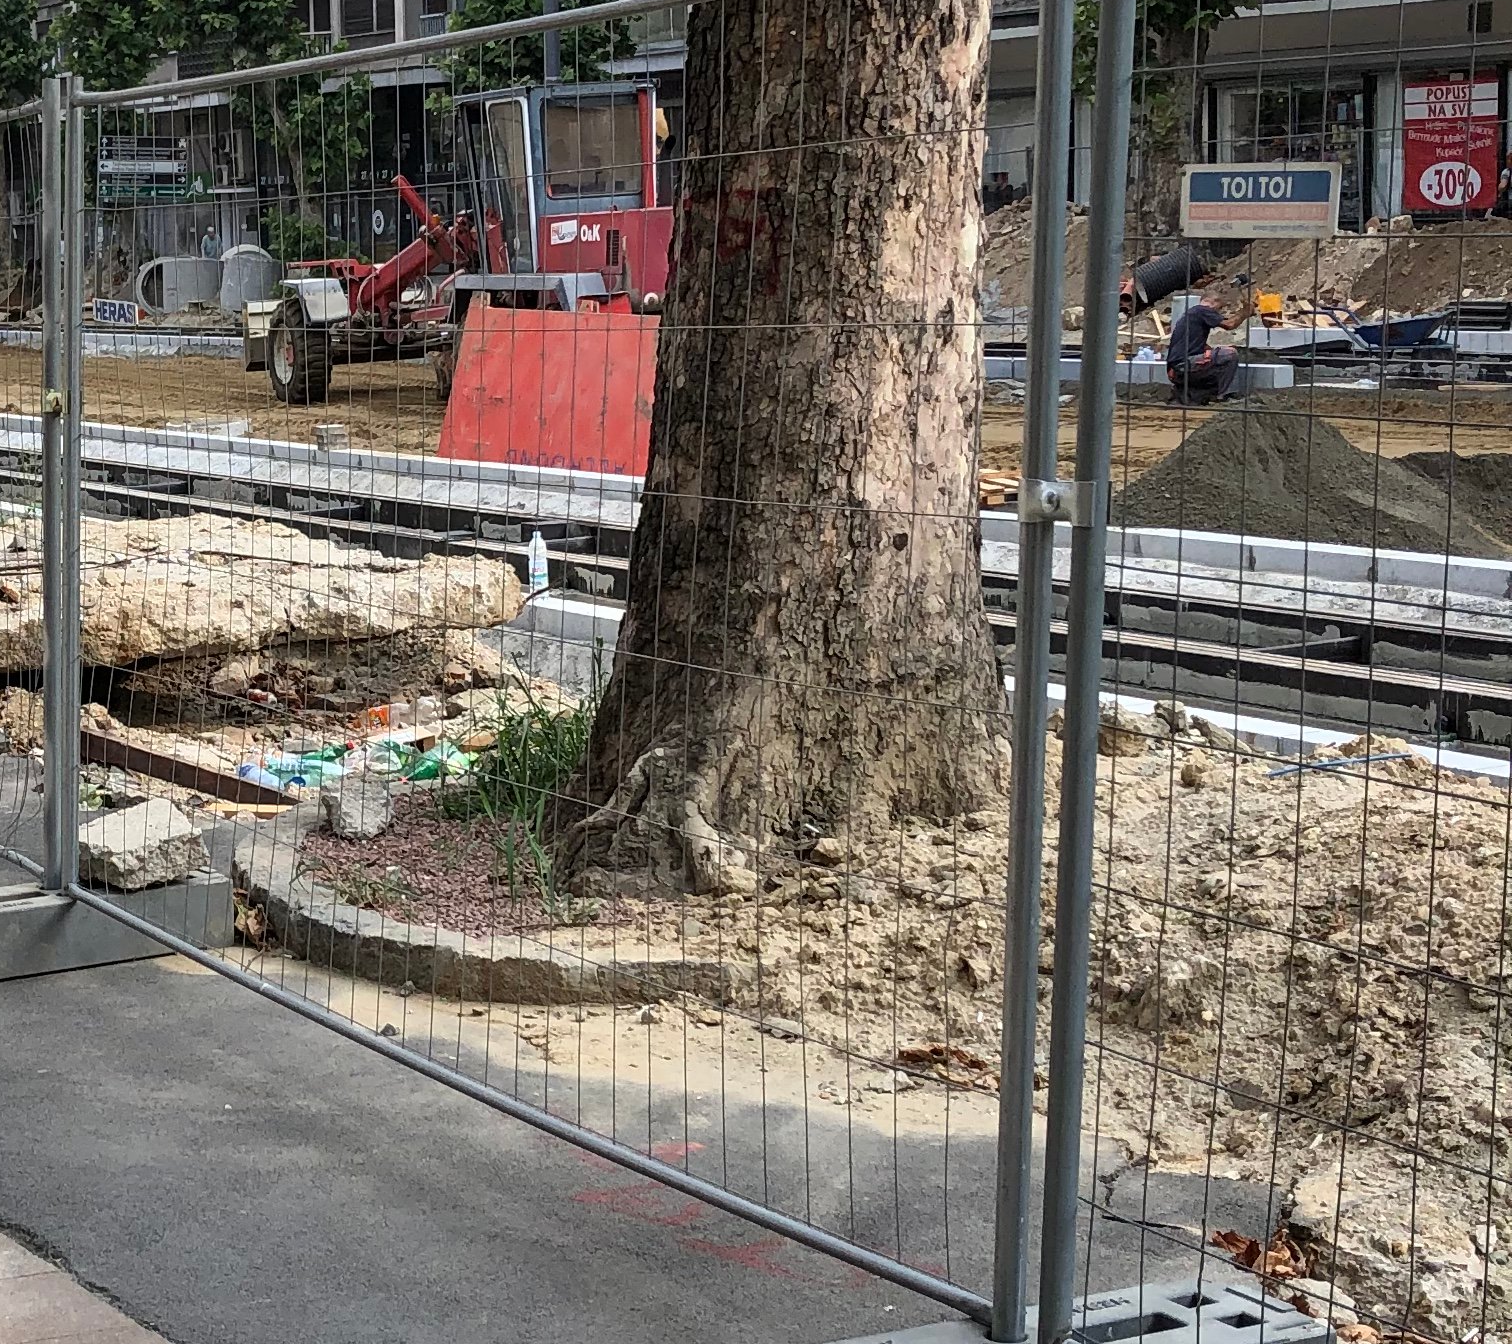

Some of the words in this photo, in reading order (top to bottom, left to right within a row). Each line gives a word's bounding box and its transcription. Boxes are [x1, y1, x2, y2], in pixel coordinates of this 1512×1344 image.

[1428, 104, 1447, 117] NA
[1220, 176, 1254, 199] TOI
[1258, 176, 1293, 199] TOI
[1427, 168, 1475, 201] -30%
[94, 299, 134, 324] HERAS
